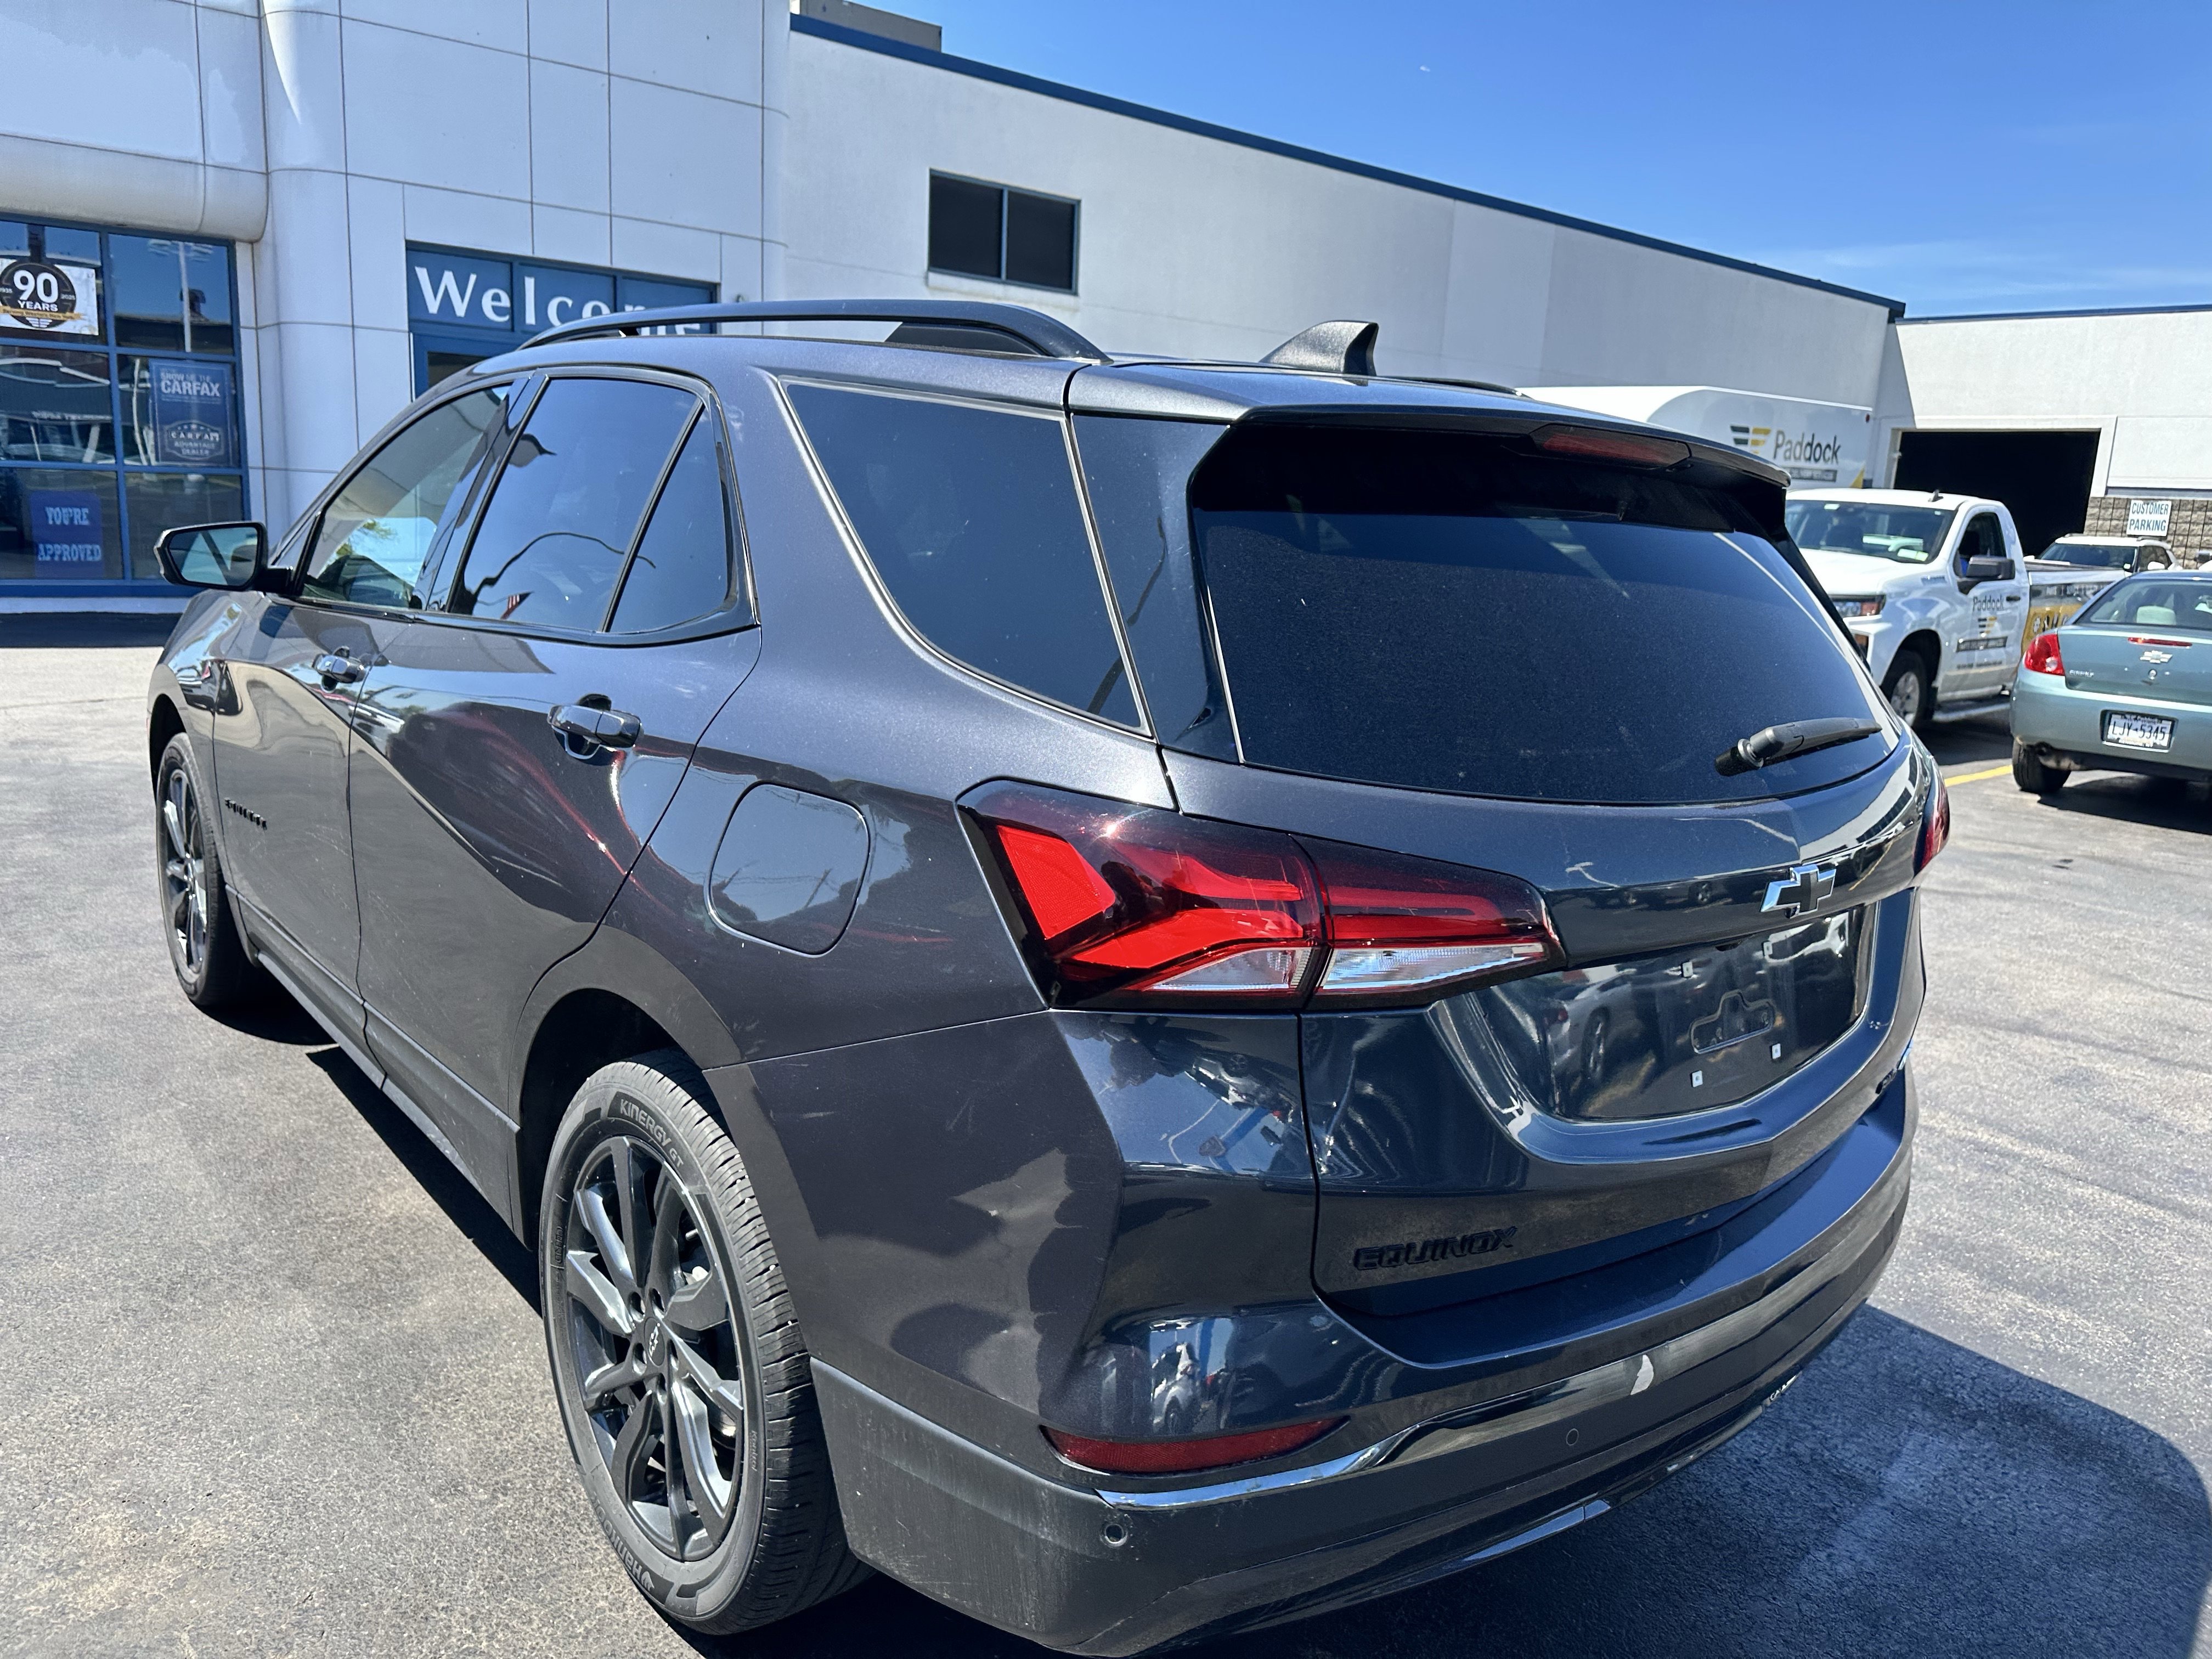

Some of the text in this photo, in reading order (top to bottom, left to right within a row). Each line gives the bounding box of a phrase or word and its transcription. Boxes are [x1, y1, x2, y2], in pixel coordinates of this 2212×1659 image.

[13, 269, 59, 303] 90
[18, 300, 58, 312] YEARS
[415, 266, 701, 336] Welco
[161, 380, 220, 397] CARFAX
[1773, 430, 1841, 464] Paddock
[2131, 502, 2169, 515] CUSTOMER
[2129, 518, 2166, 532] PARKING
[37, 543, 101, 562] APPROVED
[1972, 594, 2005, 612] Paddock
[669, 1148, 684, 1167] GT
[1353, 1225, 1519, 1271] EQUINOX
